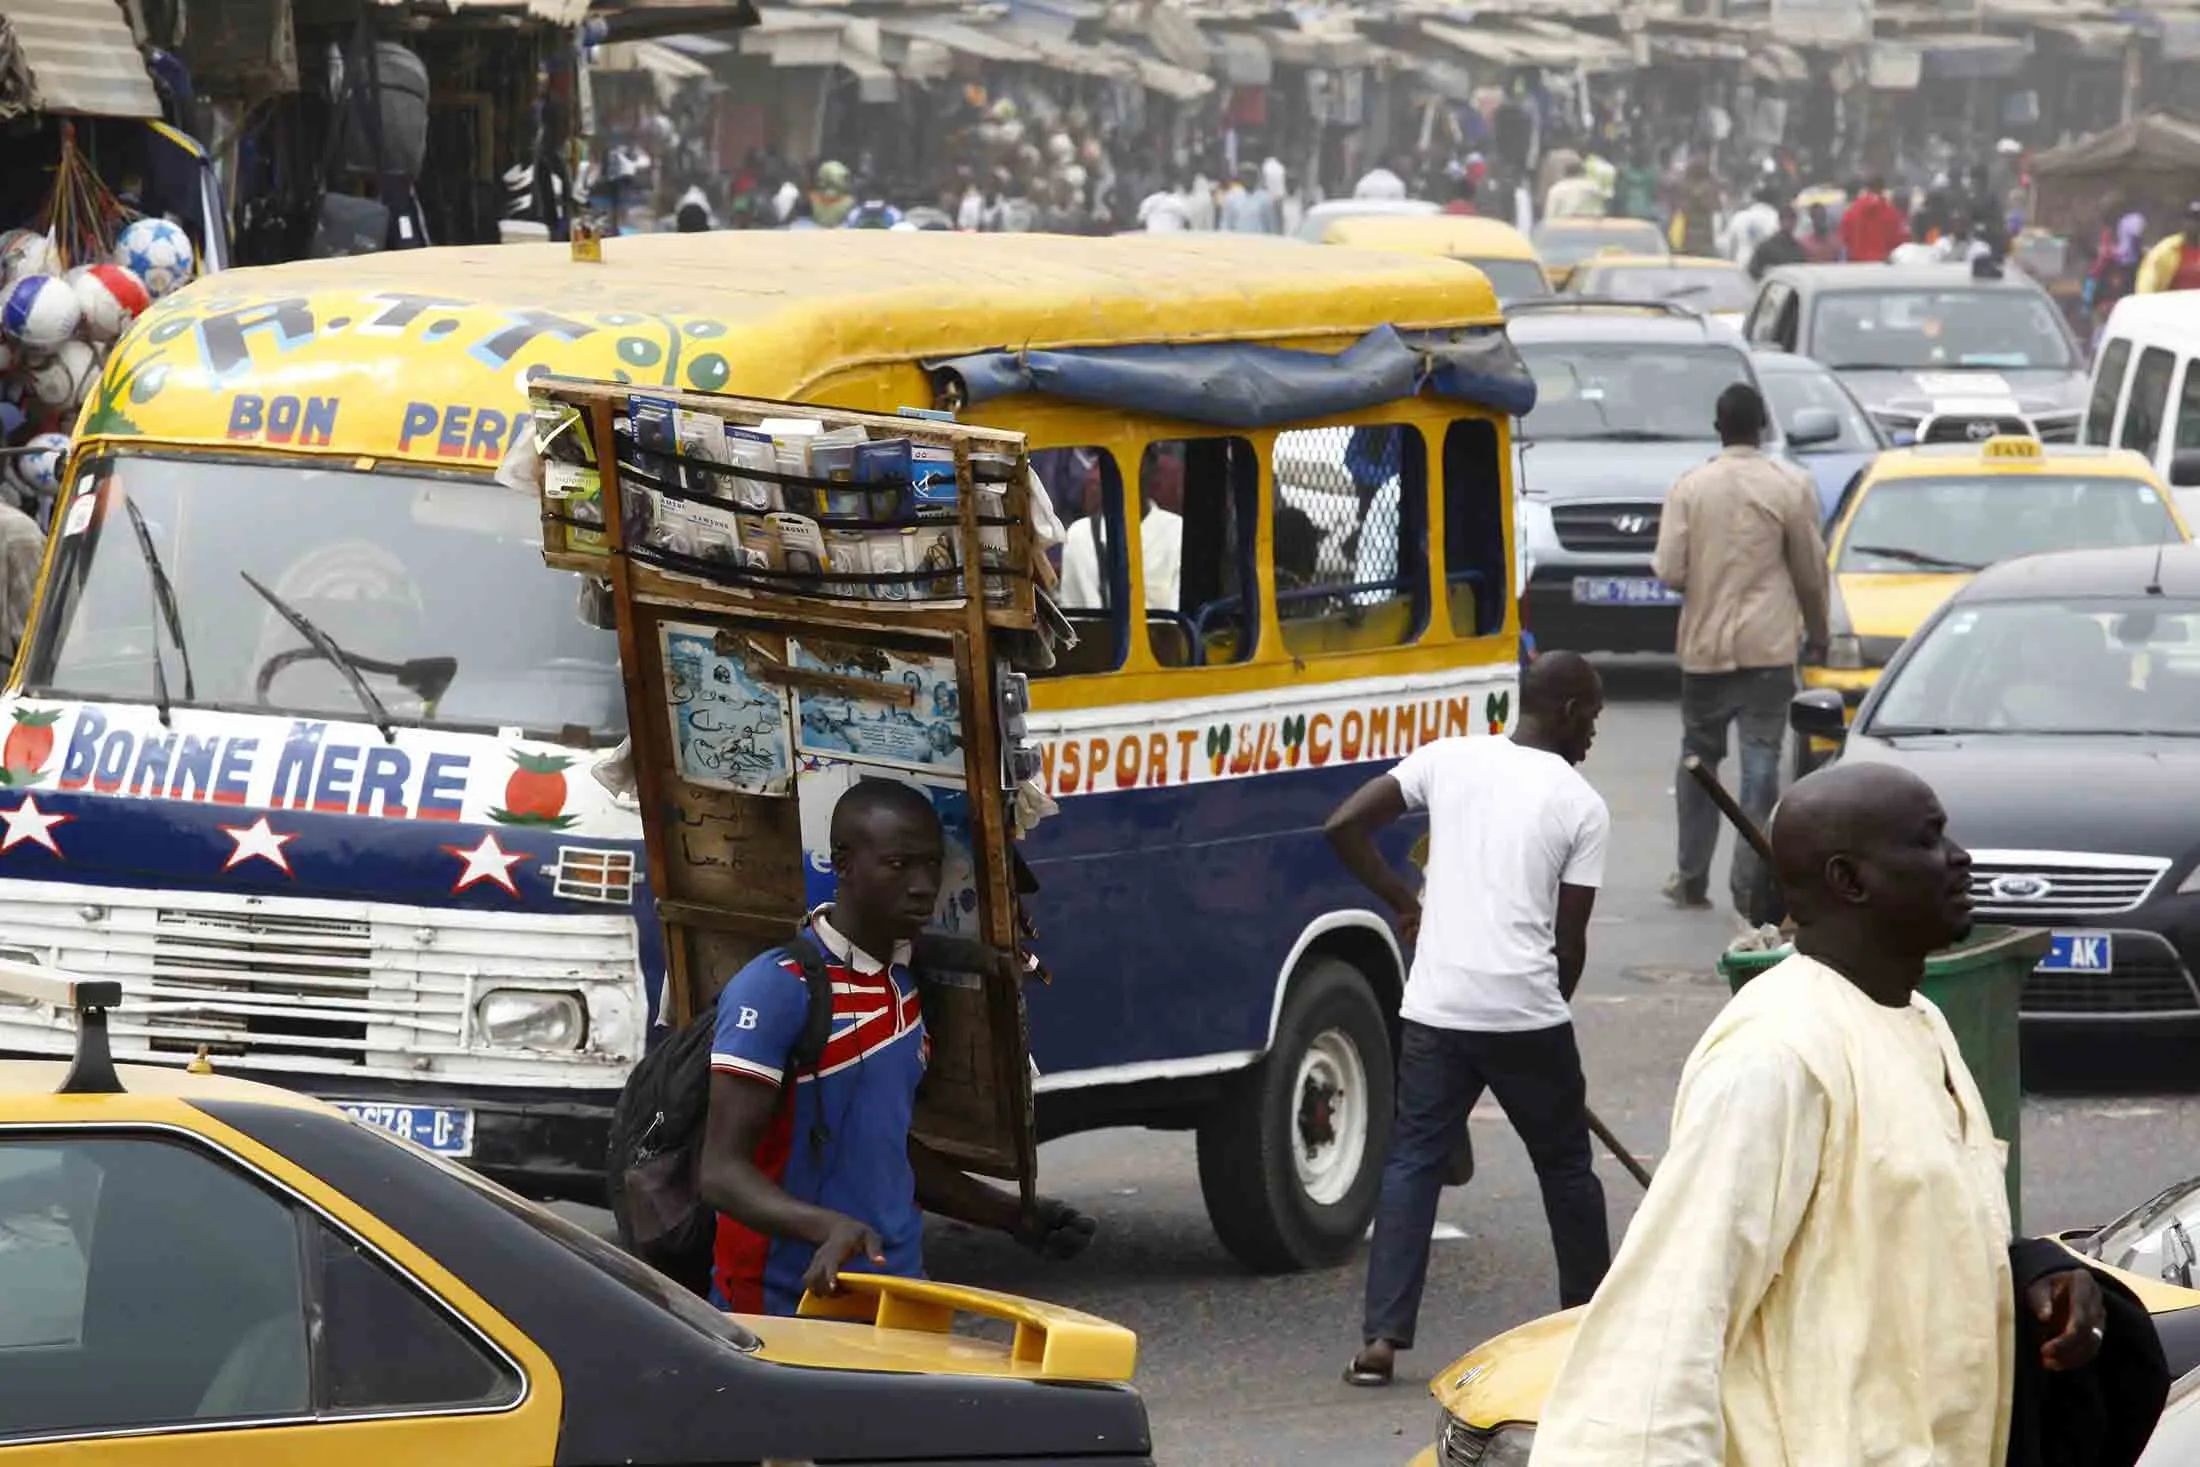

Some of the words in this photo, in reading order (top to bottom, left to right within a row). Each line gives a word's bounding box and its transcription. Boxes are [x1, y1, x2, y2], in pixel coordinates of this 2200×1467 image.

[227, 394, 340, 447] BON
[1308, 695, 1470, 766] COMMUN
[58, 705, 259, 805] BONNE
[271, 721, 471, 821] MERE
[736, 1006, 759, 1030] B
